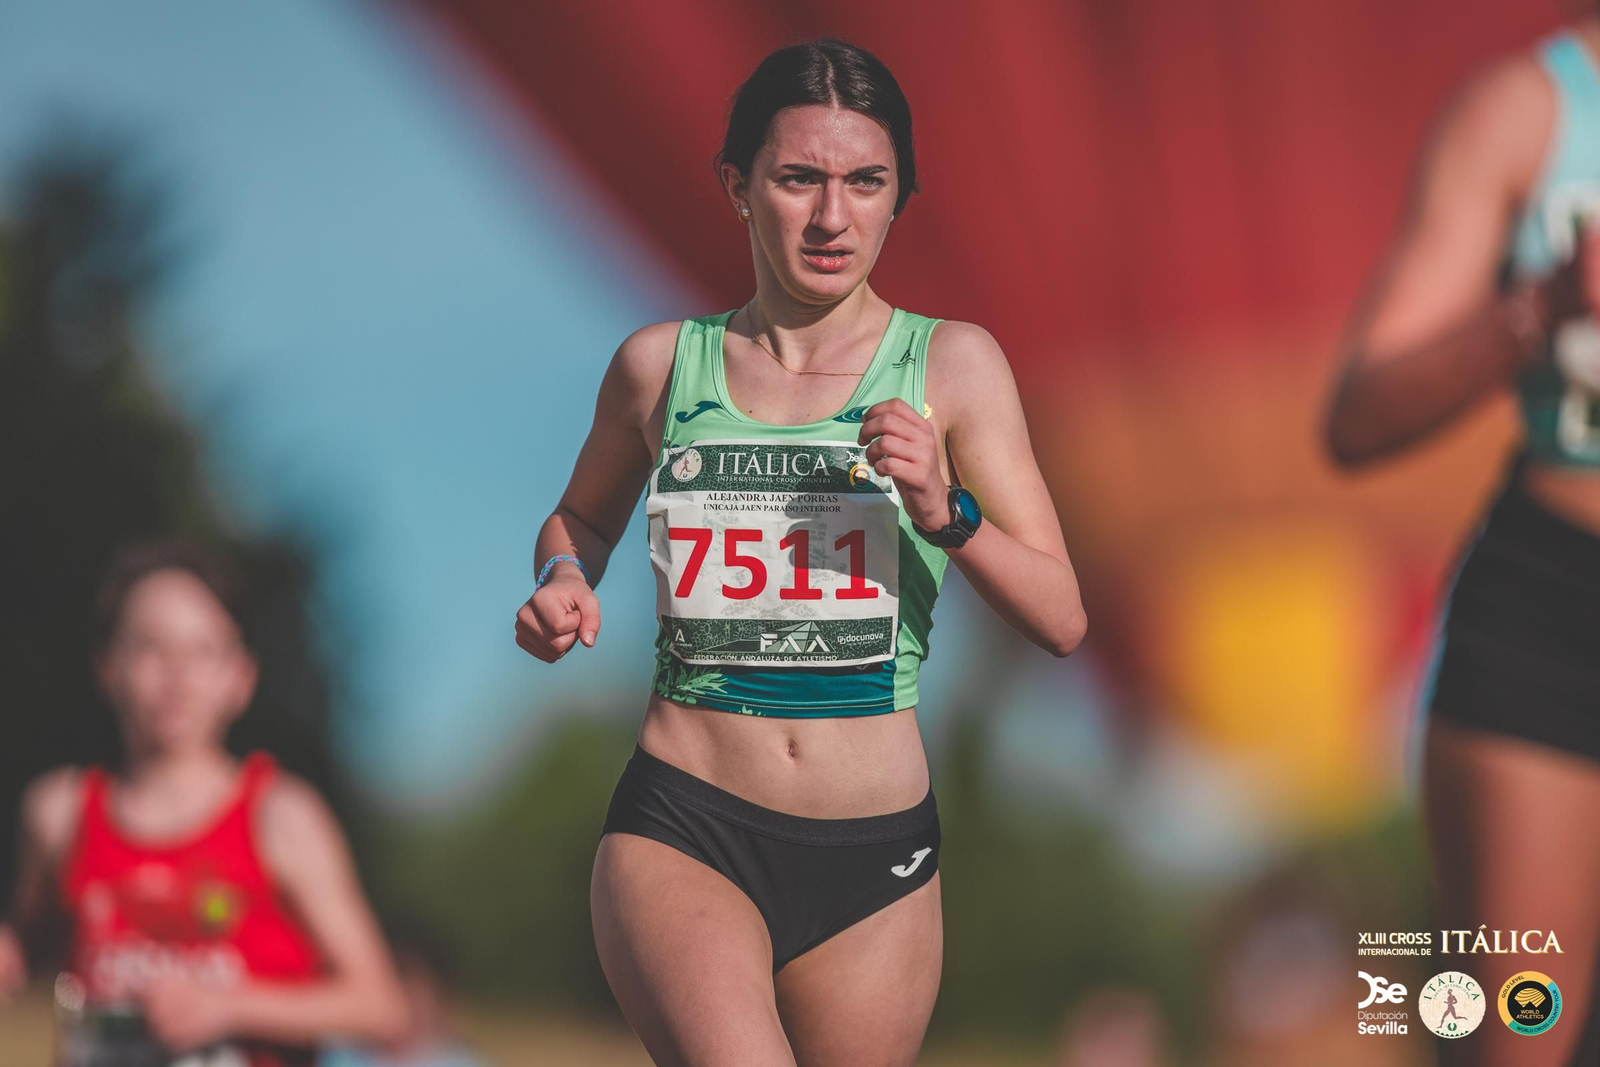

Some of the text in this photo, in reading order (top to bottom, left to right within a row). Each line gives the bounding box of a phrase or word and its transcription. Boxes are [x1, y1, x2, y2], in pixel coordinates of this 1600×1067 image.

[718, 447, 831, 476] ITÁLICA
[706, 493, 838, 503] ALEJANDRA JAEN PORRAS
[703, 503, 841, 513] UNICAJA JAEN PARAISO INTERIOR
[668, 527, 879, 600] 7511
[846, 632, 884, 642] docunova
[693, 653, 838, 662] FEDERACIÓN ANDALUZA DE ATLETISMO
